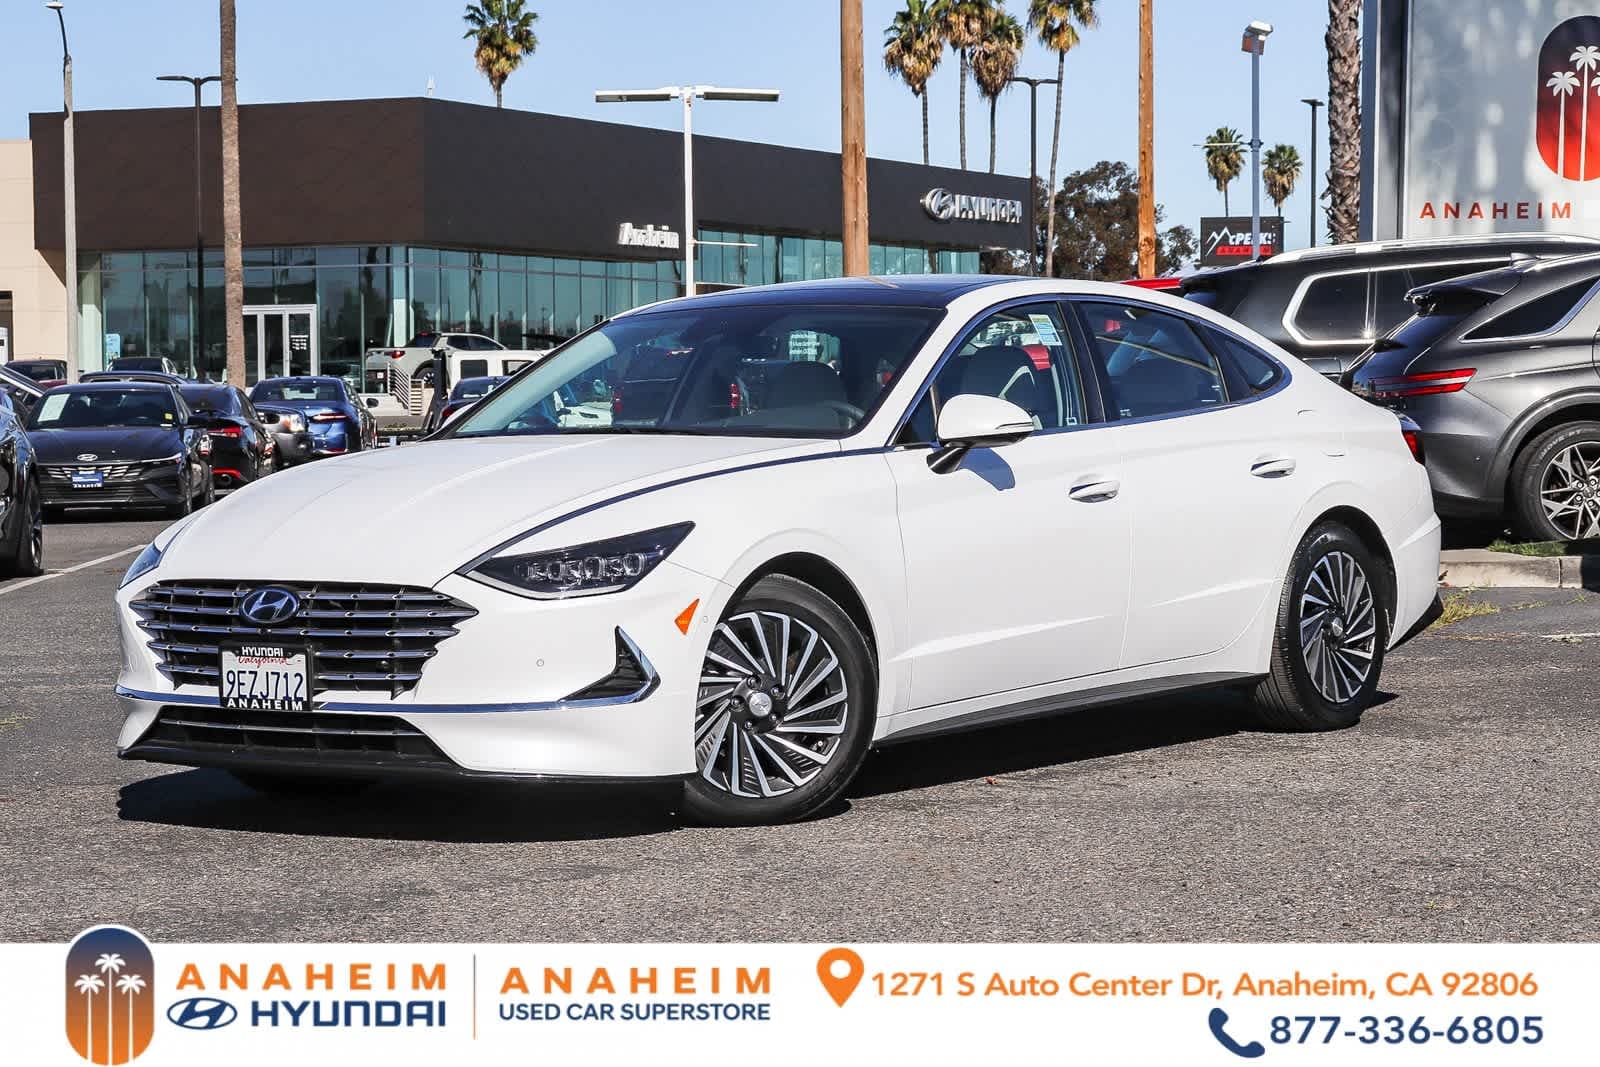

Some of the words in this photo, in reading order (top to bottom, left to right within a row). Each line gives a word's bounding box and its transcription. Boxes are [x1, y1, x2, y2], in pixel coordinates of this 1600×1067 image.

[1420, 202, 1571, 219] ANAHEIM
[241, 646, 284, 658] HYUNDAI
[226, 670, 304, 701] 9EZJ712
[227, 698, 303, 711] ANAHEIM
